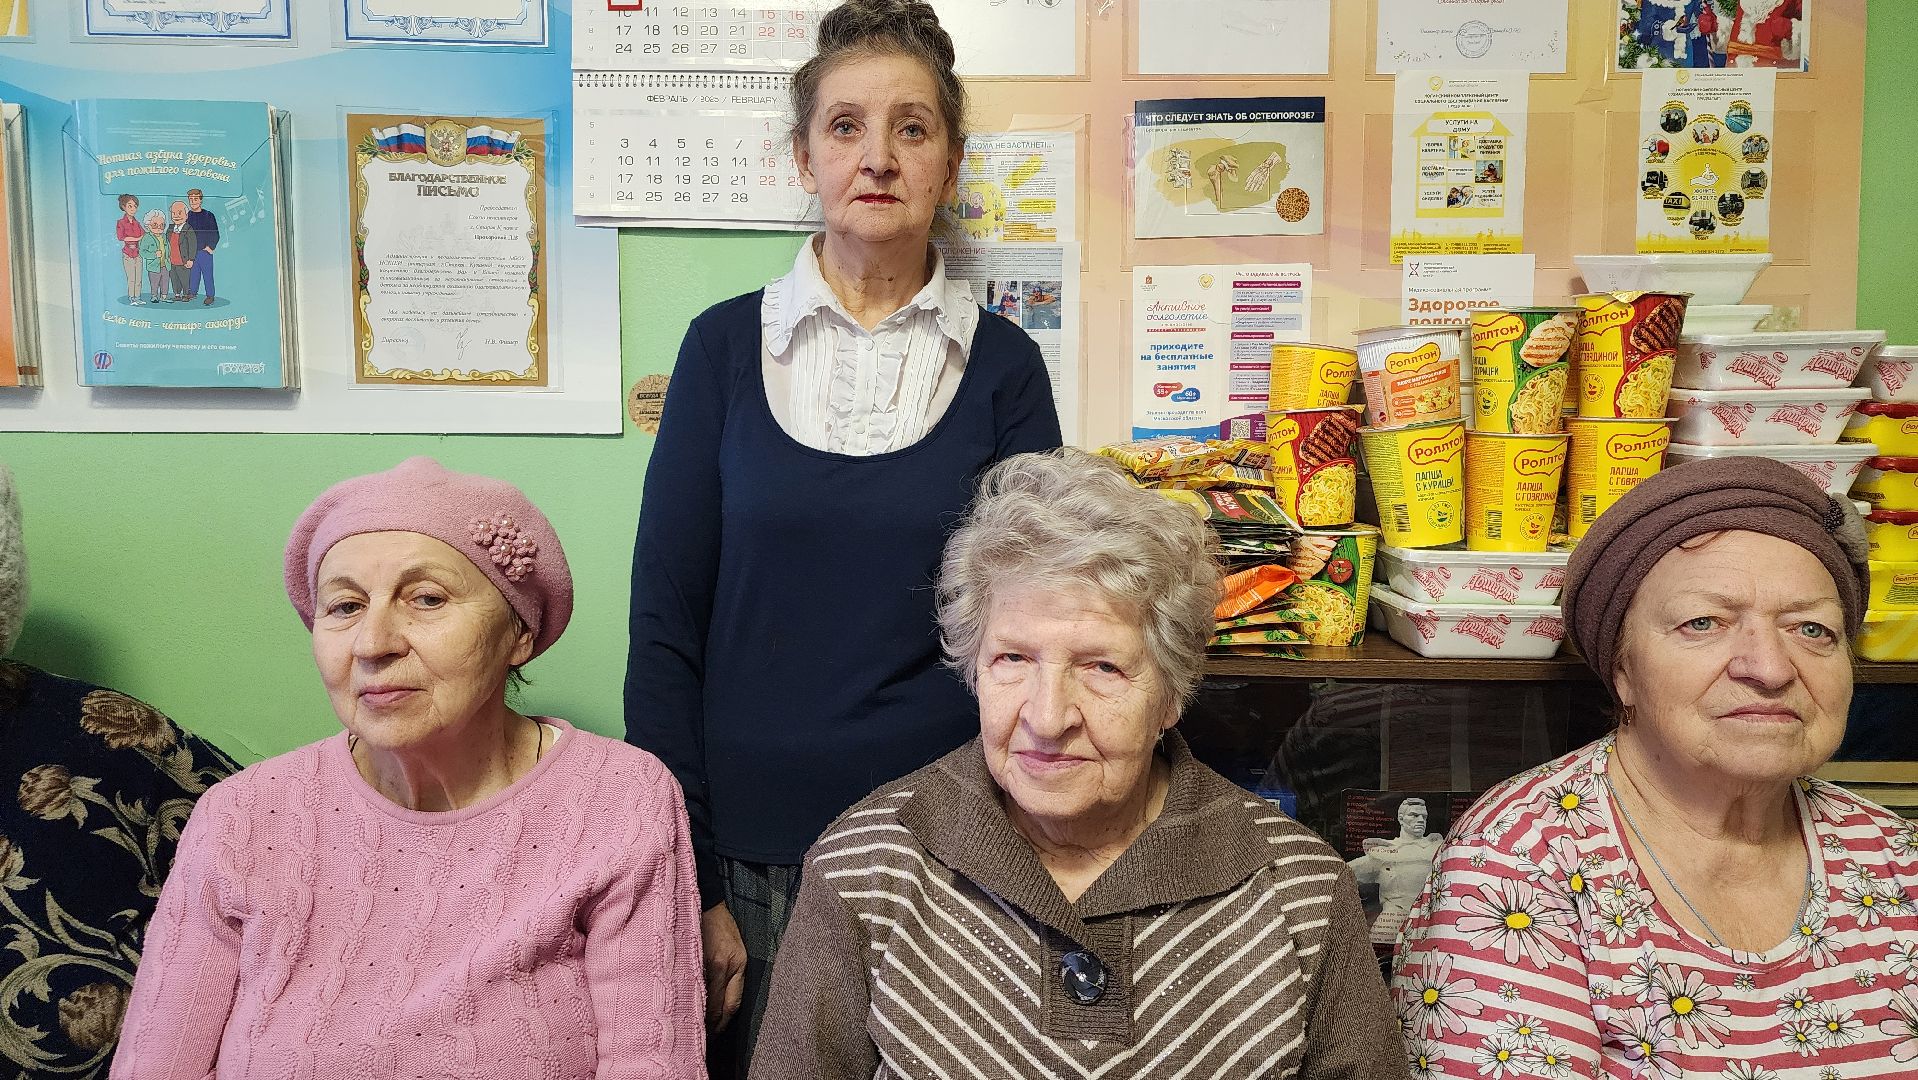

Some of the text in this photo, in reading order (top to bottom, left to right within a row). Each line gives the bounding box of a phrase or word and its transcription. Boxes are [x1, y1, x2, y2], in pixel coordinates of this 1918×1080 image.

[644, 7, 658, 17] 11
[672, 7, 688, 17] 12
[701, 8, 718, 18] 13
[729, 8, 747, 18] 14
[760, 10, 776, 20] 15
[788, 10, 805, 21] 16
[616, 25, 632, 36] 17
[644, 25, 661, 36] 18
[672, 25, 689, 36] 19
[700, 26, 718, 36] 20
[729, 26, 745, 36] 21
[758, 27, 776, 37] 22
[787, 28, 805, 39] 23
[615, 43, 632, 54] 24
[643, 43, 661, 54] 25
[671, 43, 689, 54] 26
[700, 44, 717, 54] 27
[729, 44, 747, 55] 28
[646, 94, 688, 103] ФЕВРАЛЬ
[700, 96, 720, 104] 2025
[731, 95, 777, 104] FEBRUARY
[1146, 111, 1315, 122] ЧТО СЛЕДУЕТ ЗНАТЬ ОБ ОСТЕОПОРОЗЕ?
[763, 121, 771, 132] 1
[620, 138, 629, 149] 3
[648, 138, 658, 149] 4
[677, 138, 686, 149] 5
[705, 138, 714, 149] 6
[735, 139, 743, 150] 7
[763, 139, 772, 150] 8
[145, 149, 183, 164] азбука
[186, 152, 237, 170] здоровья
[617, 156, 634, 166] 10
[645, 156, 660, 167] 11
[674, 157, 691, 167] 12
[702, 157, 719, 167] 13
[731, 157, 748, 168] 14
[759, 157, 776, 168] 15
[104, 169, 125, 184] для
[127, 165, 180, 176] пожилого
[388, 172, 507, 185] БЛАГОДАРСТВЕННОЕ
[617, 174, 633, 184] 17
[646, 174, 662, 184] 18
[674, 174, 691, 185] 19
[701, 175, 720, 185] 20
[730, 175, 746, 186] 21
[759, 175, 776, 186] 22
[416, 184, 480, 198] ПИСЬМО
[616, 190, 634, 201] 24
[645, 191, 662, 202] 25
[674, 191, 691, 202] 26
[702, 192, 719, 203] 27
[731, 193, 748, 203] 28
[1665, 197, 1682, 205] TAXI
[1146, 299, 1207, 314] Активное
[1408, 298, 1500, 314] Здоровое
[102, 310, 127, 325] Семь
[128, 319, 152, 329] нот
[162, 321, 202, 334] четыре
[205, 314, 248, 331] аккорда
[1146, 313, 1209, 321] долголетие
[1150, 342, 1204, 351] приходите
[1154, 353, 1214, 361] бесплатные
[1156, 363, 1196, 371] занятия
[1725, 356, 1784, 390] Доширак
[1765, 408, 1824, 438] Доширак
[1415, 469, 1443, 482] ЛАПША
[1609, 467, 1639, 476] ЛАПША
[1415, 476, 1454, 491] С КУРИЦЕЙ
[1516, 482, 1543, 491] ЛАПША
[1608, 477, 1614, 486] С
[1515, 492, 1521, 501] С
[1461, 574, 1520, 605] Доширак
[1451, 617, 1506, 650] Доширак
